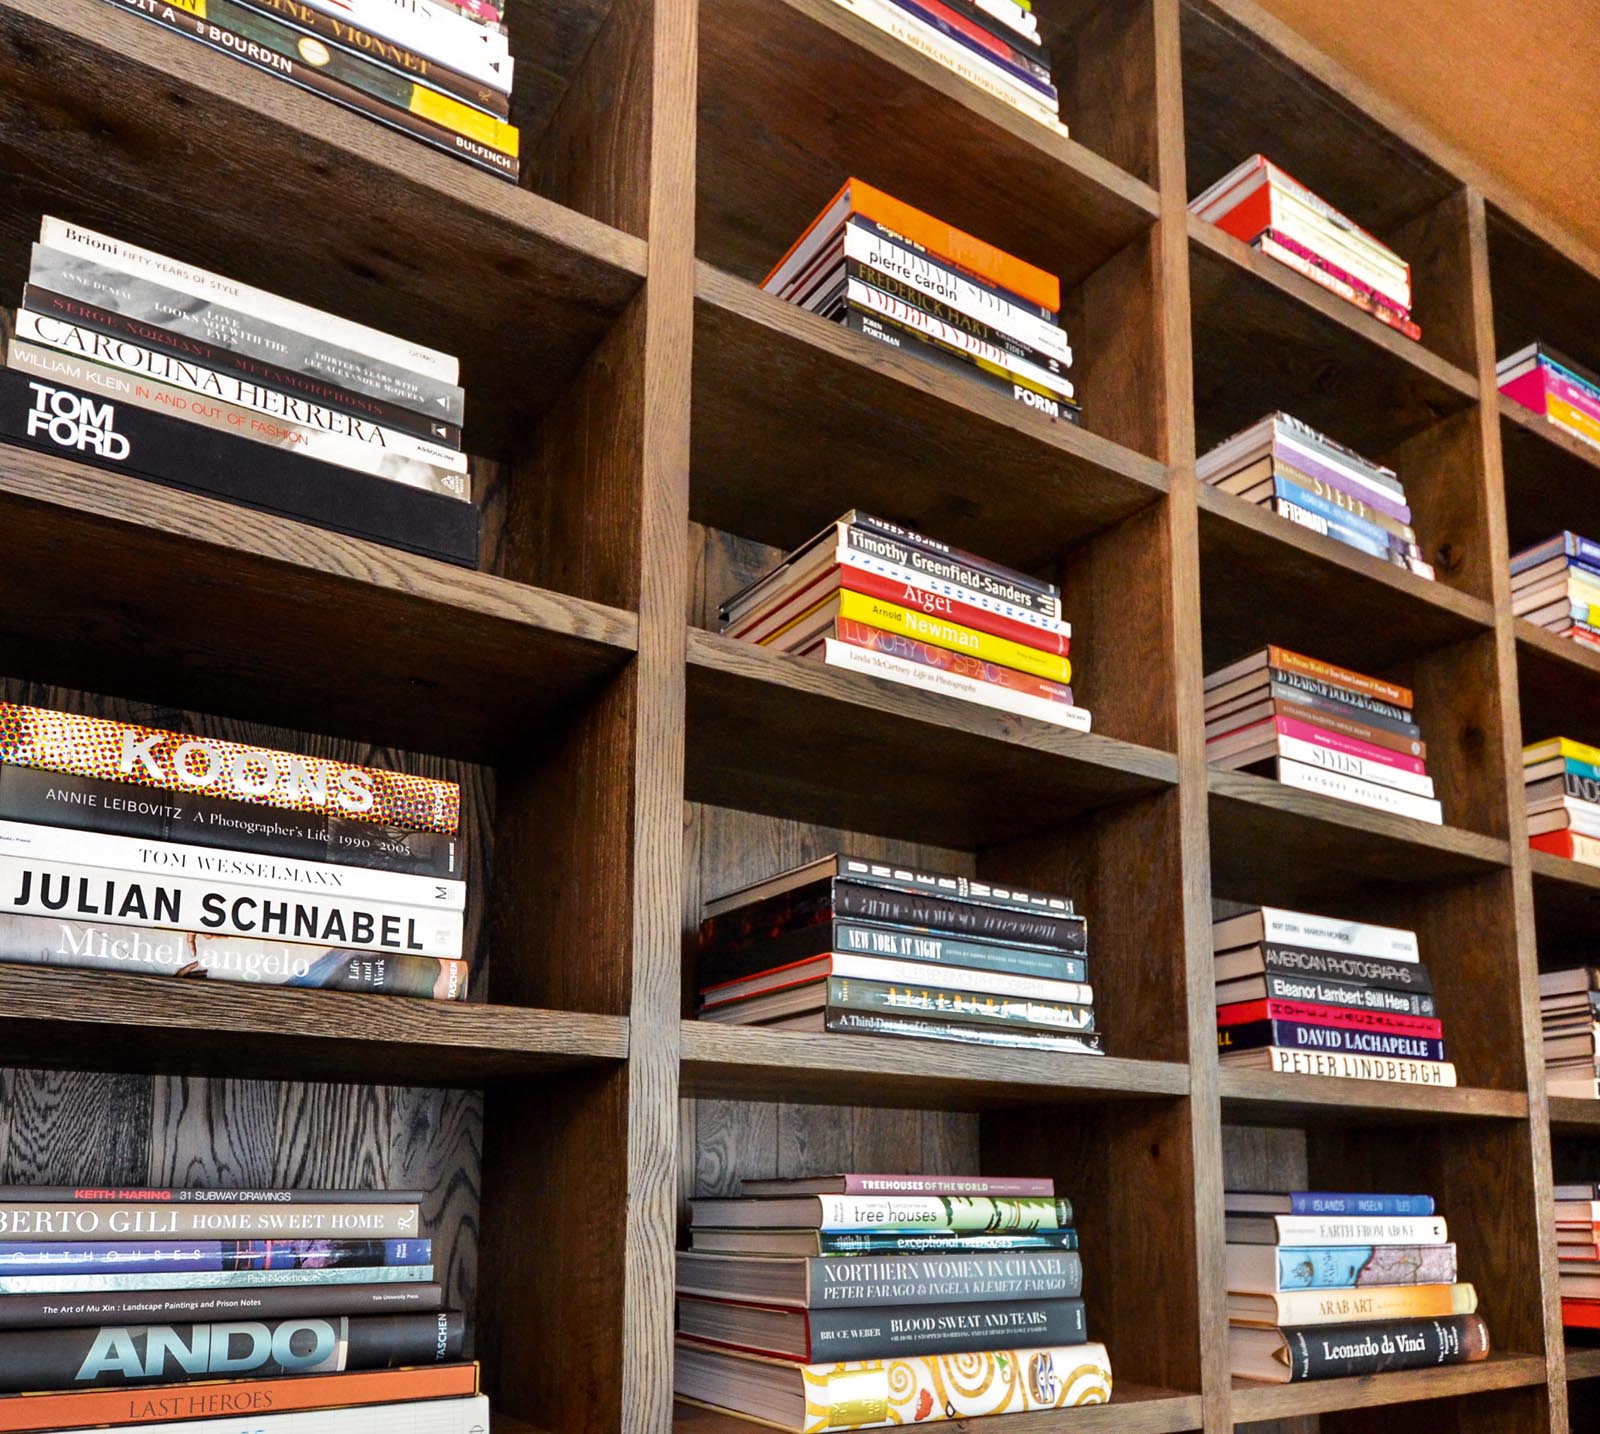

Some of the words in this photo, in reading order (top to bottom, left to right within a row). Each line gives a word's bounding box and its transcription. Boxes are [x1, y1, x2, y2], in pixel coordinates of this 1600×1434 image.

[162, 7, 176, 22] A
[209, 26, 293, 73] BOURDIN
[331, 19, 431, 74] VIONNET
[456, 136, 511, 168] BULFINCH
[65, 227, 118, 255] Brioni
[123, 250, 151, 266] FIFTY
[155, 258, 189, 281] YEARS
[193, 271, 207, 284] OF
[209, 278, 240, 297] STYLE
[869, 251, 911, 279] pierre
[915, 273, 957, 301] cardin
[858, 263, 943, 319] FREDERICK
[947, 309, 989, 339] HART
[154, 301, 200, 323] LOOKS
[202, 318, 227, 334] NOT
[227, 328, 263, 346] WITH
[263, 337, 288, 353] THE
[206, 310, 241, 330] LOVE
[863, 317, 883, 331] JOHN
[206, 330, 239, 345] EYES
[863, 325, 900, 347] PORTMAN
[1004, 342, 1025, 357] TIDES
[53, 298, 118, 328] SERGE
[127, 322, 213, 359] NORMANT
[234, 357, 384, 417] METAMORPHOSIS
[34, 315, 224, 396] CAROLINA
[237, 380, 387, 448] HERRERA
[304, 357, 322, 370] LEE
[326, 364, 381, 389] ALEXANDER
[315, 352, 362, 372] THIRTEEN
[363, 367, 393, 383] YEARS
[394, 378, 418, 393] WITH
[14, 348, 82, 379] WILLIAM
[86, 371, 131, 394] KLEIN
[135, 384, 150, 400] IN
[154, 390, 188, 411] AND
[191, 400, 222, 421] OUT
[227, 411, 246, 427] OF
[250, 419, 309, 446] FASHION
[28, 381, 115, 433] TOM
[1013, 385, 1059, 418] FORM
[27, 408, 131, 461] FORD
[850, 530, 908, 566] Timothy
[912, 552, 1032, 607] Greenfield-Sanders
[903, 585, 953, 613] Atget
[873, 605, 902, 621] Arnold
[905, 611, 980, 649] Newman
[845, 620, 918, 657] LUXURY
[924, 645, 944, 665] OF
[953, 651, 1008, 684] SPACE
[850, 651, 871, 664] Linda
[873, 657, 911, 675] McCartney
[913, 669, 926, 680] Life
[120, 730, 373, 813] KOONS
[1313, 747, 1363, 775] STYLIST
[1566, 770, 1600, 804] LIND
[46, 788, 97, 807] ANNIE
[103, 796, 182, 820] LEIBOVITZ
[193, 811, 205, 823] A
[210, 813, 303, 839] Photographer's
[307, 828, 330, 843] Life
[339, 835, 371, 848] 1990
[380, 841, 410, 857] 2005
[139, 848, 187, 869] TOM
[198, 855, 343, 886] WESSELMANN
[14, 870, 182, 923] JULIAN
[199, 893, 424, 951] SCHNABEL
[56, 924, 186, 967] Michel
[201, 946, 310, 981] angelo
[849, 930, 869, 949] NEW
[872, 933, 897, 953] YORK
[901, 938, 912, 955] AT
[914, 939, 942, 959] NIGHT
[349, 959, 360, 981] Life
[364, 961, 372, 981] and
[374, 959, 385, 987] Work
[447, 962, 458, 999] TASCHEN
[1266, 949, 1327, 971] AMERICAN
[1327, 958, 1411, 984] PHOTOGRAPHS
[1273, 979, 1316, 997] Eleanor
[1317, 985, 1365, 1005] Lambert:
[1365, 990, 1385, 1008] Still
[1385, 996, 1410, 1012] Here
[840, 1014, 849, 1025] A
[849, 1015, 873, 1028] Third
[1297, 1028, 1342, 1047] DAVID
[1344, 1033, 1429, 1057] LACHAPELLE
[1280, 1052, 1337, 1076] PETER
[1343, 1057, 1441, 1083] LINDBERGH
[74, 1190, 116, 1199] KEITH
[119, 1189, 172, 1200] HARING
[180, 1191, 192, 1200] 31
[195, 1191, 238, 1201] SUBWAY
[240, 1191, 292, 1202] DRAWINGS
[862, 1180, 924, 1190] TREEHOUSES
[924, 1182, 935, 1190] OF
[938, 1182, 956, 1191] THE
[956, 1183, 988, 1191] WORLD
[855, 1205, 884, 1222] tree
[888, 1201, 937, 1222] houses
[1313, 1200, 1345, 1211] ISLANDS
[108, 1211, 180, 1233] GILI
[192, 1215, 251, 1229] HOME
[258, 1214, 325, 1229] SWEET
[331, 1214, 384, 1229] HOME
[1319, 1225, 1353, 1238] EARTH
[1355, 1224, 1385, 1238] FROM
[1387, 1224, 1415, 1237] ABOVE
[897, 1233, 959, 1252] exceptional
[824, 1262, 919, 1282] NORTHERN
[923, 1260, 984, 1278] WOMEN
[988, 1261, 1002, 1277] IN
[1006, 1258, 1066, 1277] CHANEL
[372, 1294, 383, 1302] Yale
[383, 1293, 406, 1302] University
[407, 1293, 419, 1301] Press
[824, 1286, 863, 1300] PETER
[867, 1284, 915, 1298] FARAGO
[917, 1284, 927, 1296] &
[929, 1282, 970, 1296] INGELA
[973, 1280, 1022, 1293] KLEMETZ
[1025, 1278, 1066, 1292] FARAGO
[43, 1305, 58, 1314] The
[60, 1305, 74, 1313] Art
[75, 1304, 84, 1313] of
[86, 1304, 100, 1313] Mu
[102, 1304, 115, 1312] Xin
[122, 1302, 162, 1313] Landscape
[164, 1300, 199, 1311] Paintings
[200, 1300, 214, 1309] and
[216, 1299, 239, 1308] Prison
[243, 1298, 261, 1308] Notes
[1319, 1300, 1350, 1316] ARAB
[1353, 1298, 1374, 1313] ART
[436, 1313, 448, 1360] TASCHEN
[820, 1331, 849, 1341] BRUCE
[851, 1328, 881, 1339] WEBER
[891, 1318, 936, 1333] BLOOD
[938, 1315, 981, 1330] SWEAT
[984, 1313, 1008, 1327] AND
[1009, 1311, 1047, 1325] TEARS
[74, 1319, 336, 1381] ANDO
[1323, 1336, 1379, 1360] Leonardo
[1381, 1335, 1395, 1354] da
[1395, 1333, 1425, 1352] Vinci
[129, 1397, 184, 1419] LAST
[189, 1390, 273, 1413] HEROES
